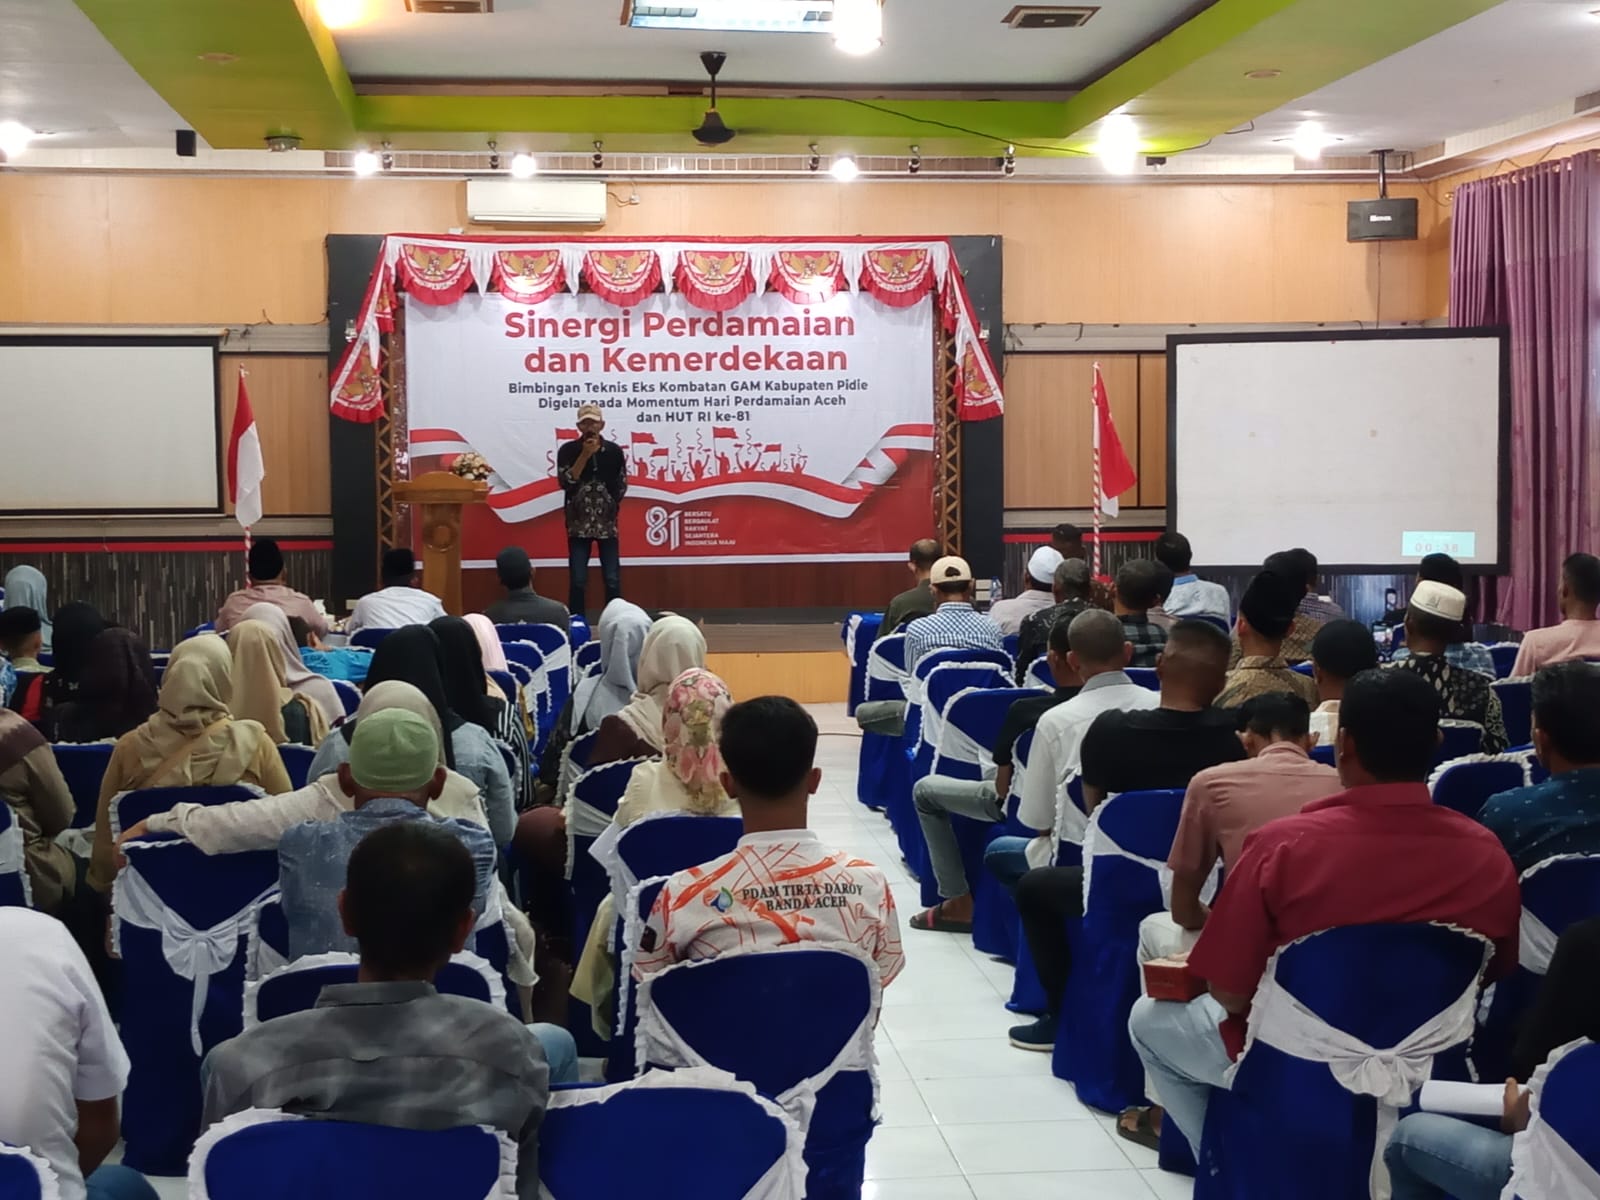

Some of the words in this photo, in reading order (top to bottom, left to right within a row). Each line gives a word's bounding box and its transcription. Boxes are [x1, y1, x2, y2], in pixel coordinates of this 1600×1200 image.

[505, 309, 631, 344] Sinergi
[643, 308, 854, 338] Perdamaian
[524, 346, 590, 373] dan
[602, 344, 847, 372] Kemerdekaan
[508, 382, 580, 395] Bimbingan
[584, 382, 628, 393] Teknis
[632, 382, 655, 393] Eks
[659, 381, 726, 392] Kombatan
[730, 381, 761, 391] GAM
[764, 380, 834, 393] Kabupaten
[837, 378, 868, 390] Pidie
[538, 397, 587, 411] Digelar
[627, 396, 700, 408] Momentum
[704, 395, 730, 407] Hari
[734, 395, 810, 406] Perdamaian
[814, 395, 846, 406] Aceh
[636, 412, 661, 423] dan
[665, 412, 693, 422] HUT
[698, 411, 711, 422] RI
[716, 411, 750, 421] ke-81
[645, 506, 682, 551] 81
[742, 885, 779, 900] PDAM
[782, 884, 820, 898] TIRTA
[825, 883, 863, 896] DAROY
[767, 899, 811, 911] BANDA
[815, 896, 847, 909] ACEH
